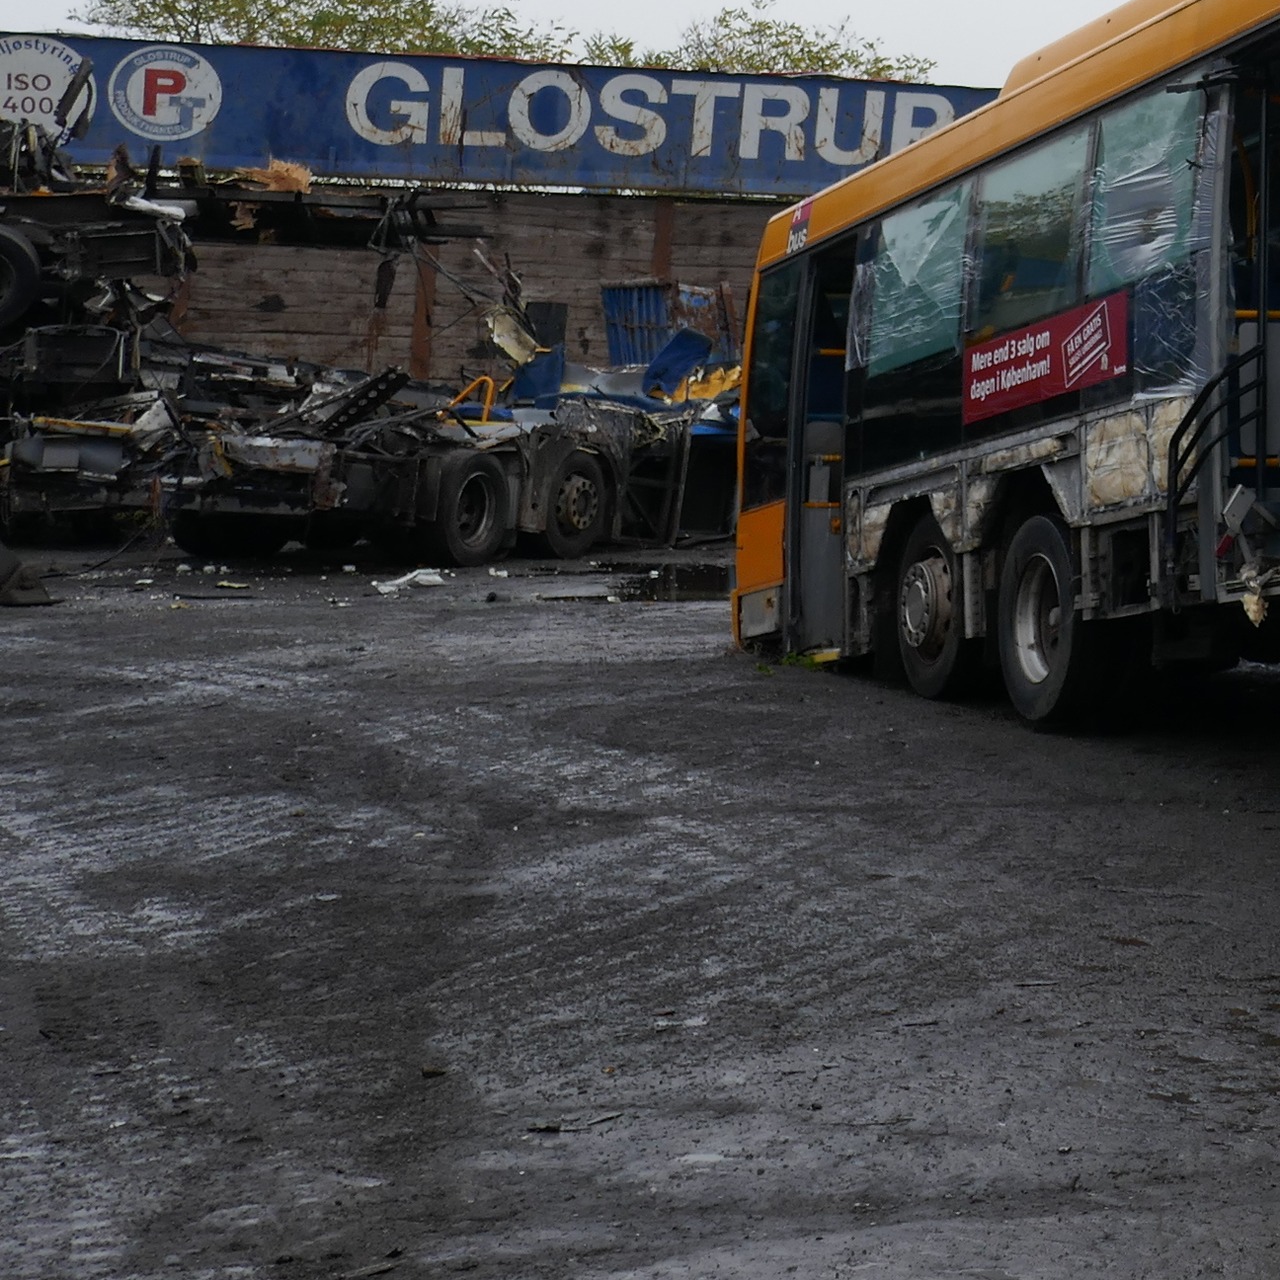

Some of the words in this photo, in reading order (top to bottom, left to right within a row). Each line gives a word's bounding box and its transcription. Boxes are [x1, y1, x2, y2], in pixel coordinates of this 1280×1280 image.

[6, 73, 52, 91] ISO
[2, 96, 54, 114] 400
[345, 61, 956, 166] GLOSTRUP
[971, 352, 992, 373] Mere
[994, 345, 1009, 363] end
[1010, 340, 1016, 359] 3
[1017, 333, 1034, 358] salg
[1036, 330, 1050, 351] om
[970, 378, 996, 401] dagen
[996, 371, 1000, 392] i
[1001, 354, 1050, 392] København!
